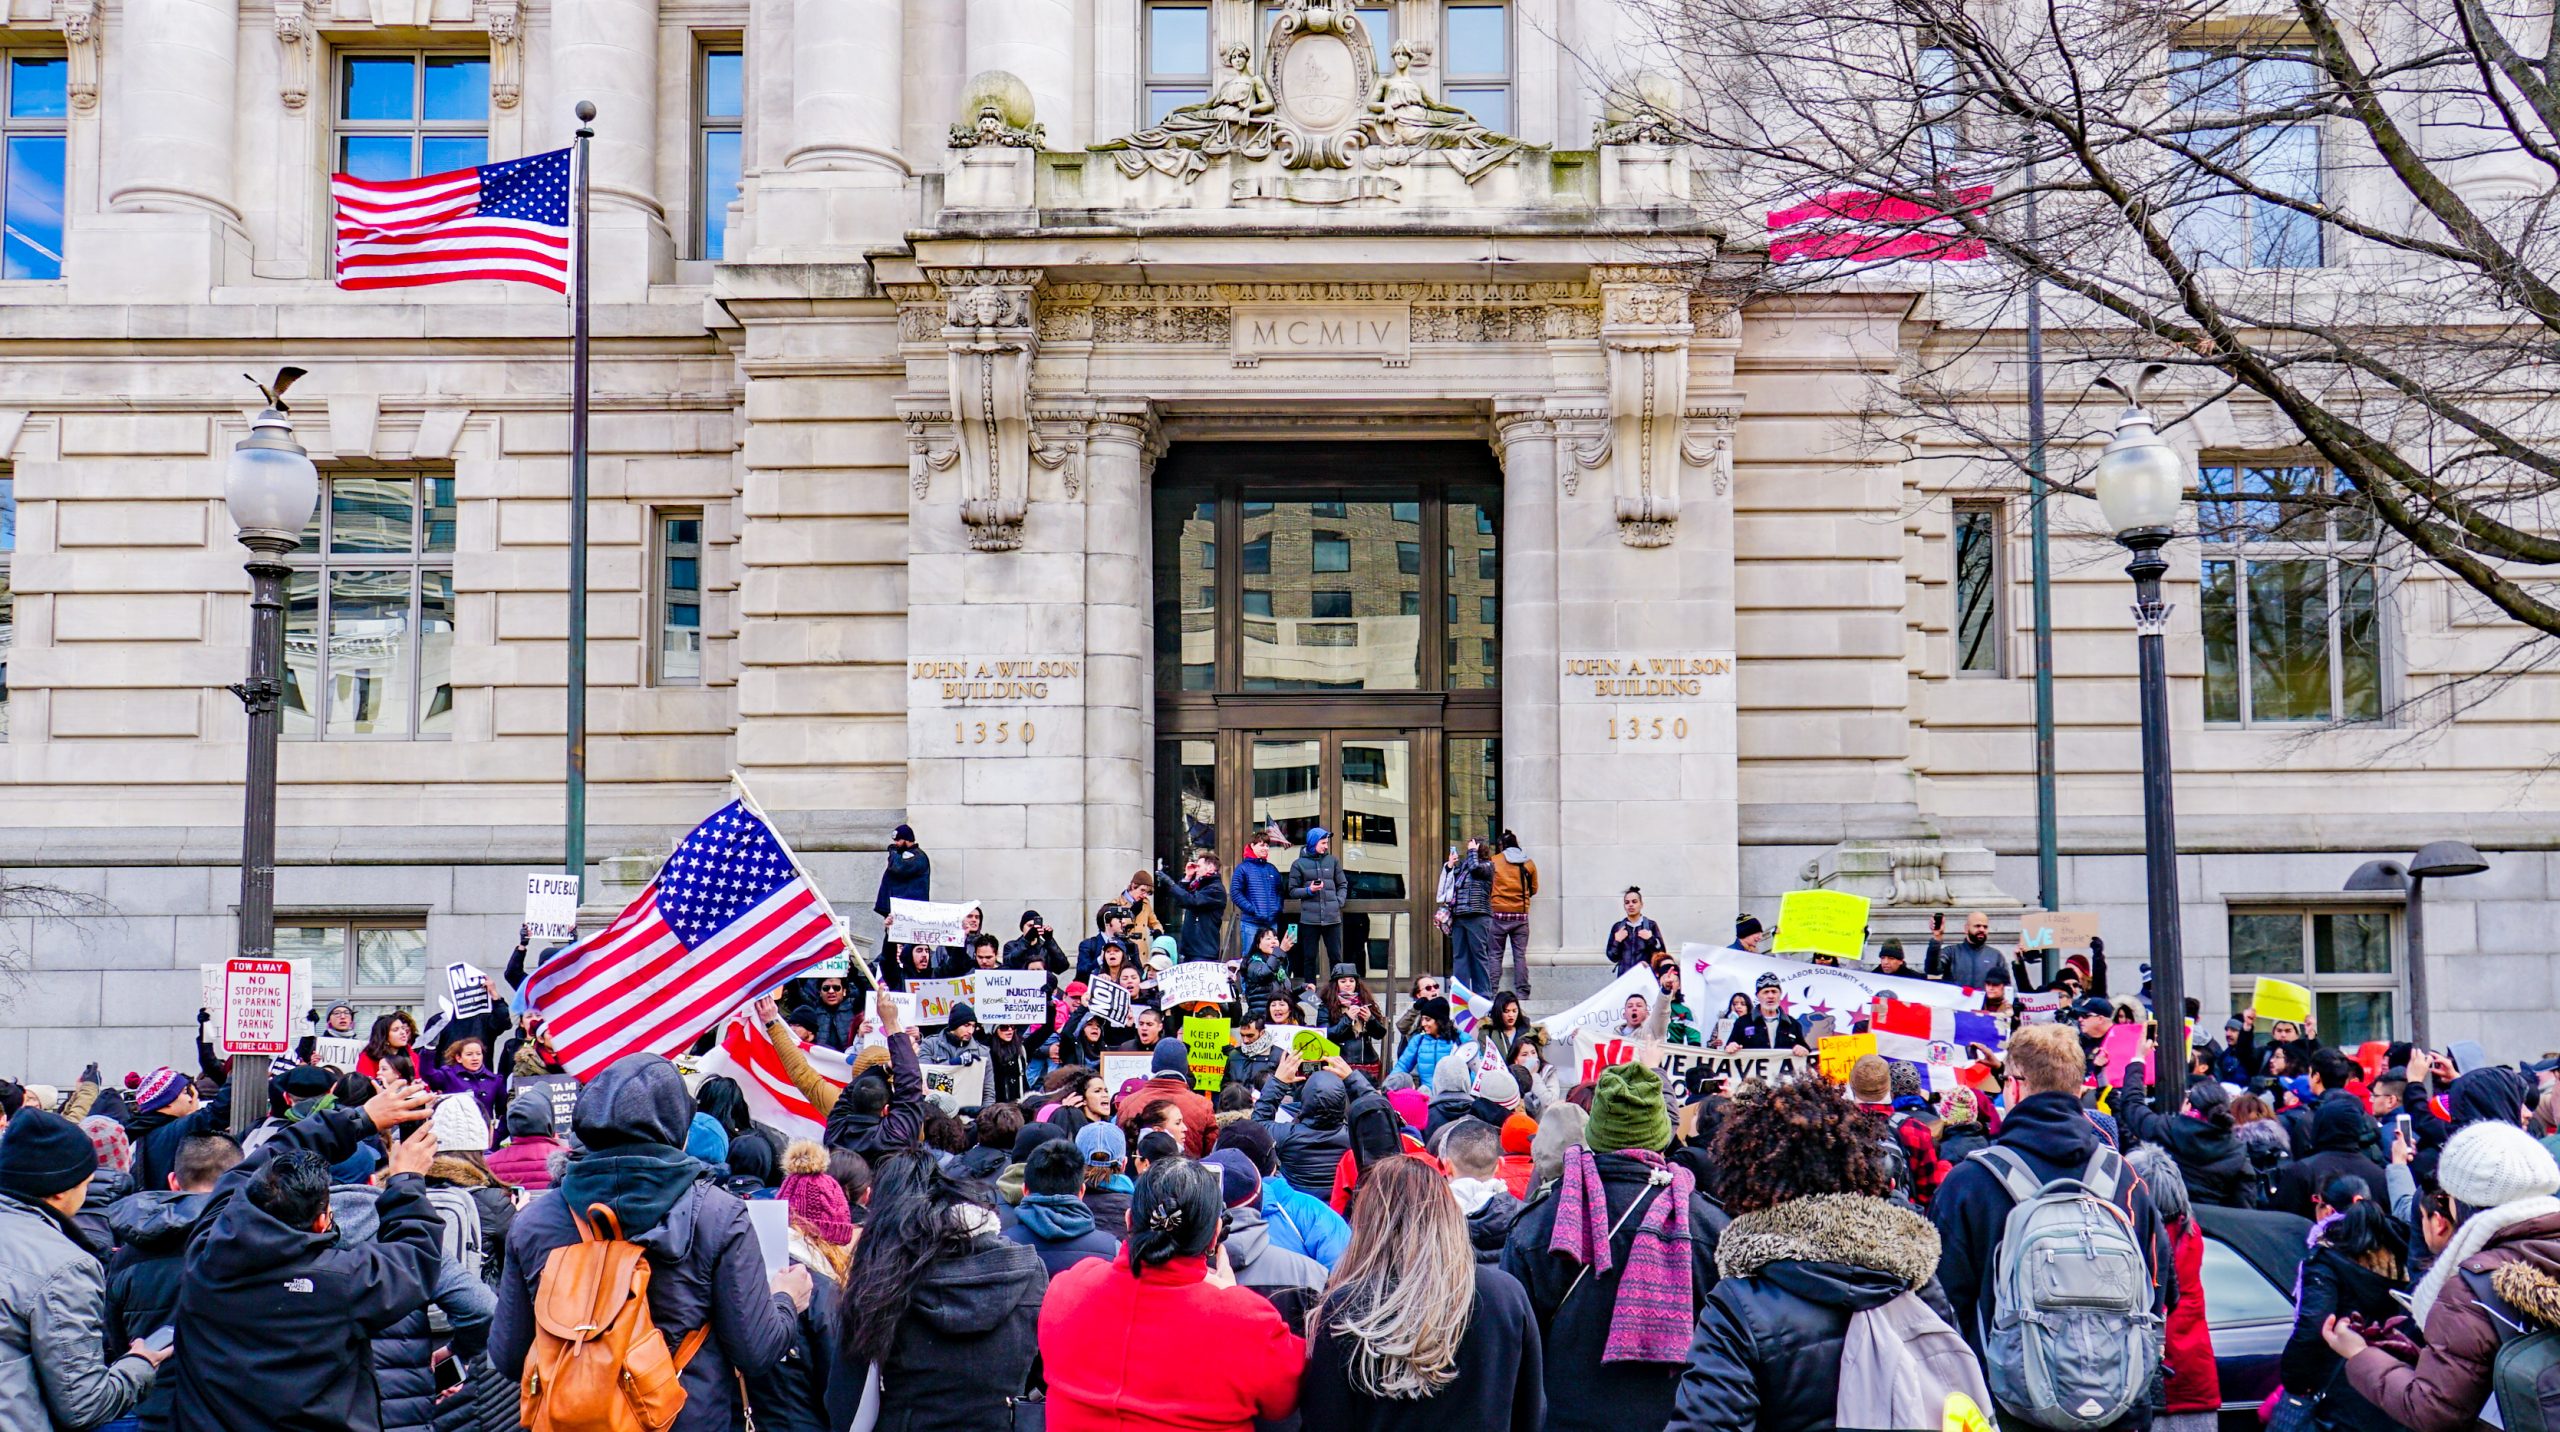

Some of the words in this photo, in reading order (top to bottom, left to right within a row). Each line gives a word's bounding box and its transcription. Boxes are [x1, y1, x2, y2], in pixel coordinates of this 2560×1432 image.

[1252, 321, 1391, 345] MCMIV
[912, 662, 968, 679] JOHN
[995, 661, 1079, 678] WILSON
[1565, 659, 1620, 676] JOHN
[1648, 658, 1732, 675] WILSON
[942, 683, 1048, 699] BUILDING
[1595, 680, 1701, 696] BUILDING
[956, 720, 1035, 744] 1350
[1608, 717, 1688, 740] 1350
[529, 879, 540, 894] EL
[544, 879, 578, 896] PUEBLO
[913, 931, 940, 944] NEVER
[2022, 927, 2054, 949] WE
[233, 962, 252, 971] TOW
[256, 962, 283, 972] AWAY
[1158, 963, 1228, 982] IMMIGRANTS
[248, 976, 266, 985] NO
[1175, 972, 1205, 983] MAKE
[1787, 968, 1814, 982] LABOR
[1814, 968, 1859, 985] SOLIDARITY
[984, 976, 1012, 987] WHEN
[235, 986, 280, 997] STOPPING
[1006, 987, 1046, 998] INJUSTICE
[1169, 981, 1221, 994] AMERICA
[1858, 982, 1874, 996] AND
[1090, 980, 1114, 1017] NO!
[1180, 990, 1213, 999] GREAT
[232, 998, 242, 1006] OR
[245, 997, 281, 1008] PARKING
[982, 997, 1009, 1006] BECOMES
[239, 1008, 274, 1018] COUNCIL
[1004, 1004, 1045, 1013] RESISTANCE
[2023, 1003, 2058, 1012] uman
[1015, 1013, 1038, 1021] DUTY
[238, 1019, 274, 1030] PARKING
[240, 1031, 270, 1040] ONLY
[1190, 1030, 1220, 1040] KEEP
[227, 1042, 233, 1050] IF
[257, 1042, 273, 1051] CALL
[1193, 1040, 1215, 1050] OUR
[1821, 1036, 1860, 1052] Deport
[320, 1045, 340, 1063] NOT
[1191, 1051, 1224, 1060] AMILIA
[1696, 1056, 1770, 1081] HAVE
[564, 1082, 577, 1091] MI
